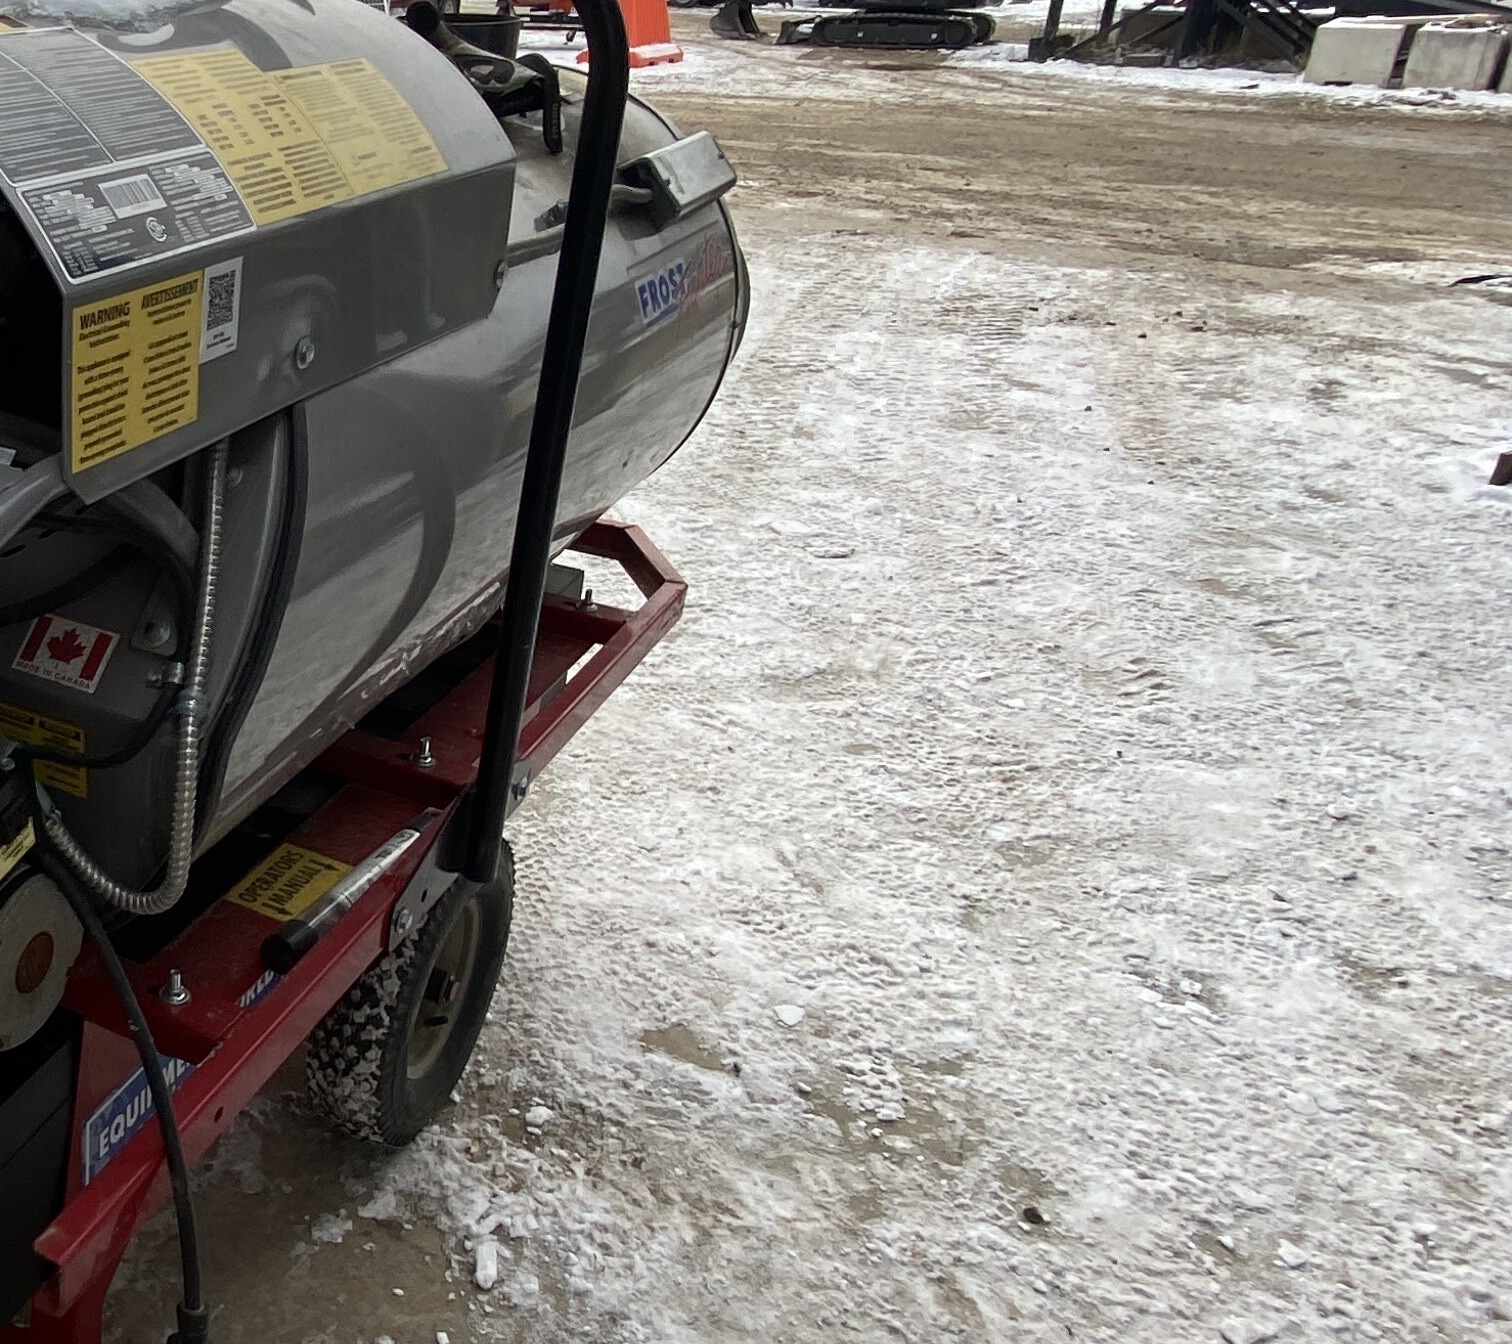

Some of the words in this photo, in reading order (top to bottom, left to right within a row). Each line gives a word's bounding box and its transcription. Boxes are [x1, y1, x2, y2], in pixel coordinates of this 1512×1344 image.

[79, 301, 130, 330] WARNING
[54, 671, 91, 690] CANADA
[268, 864, 323, 907] MANUAL
